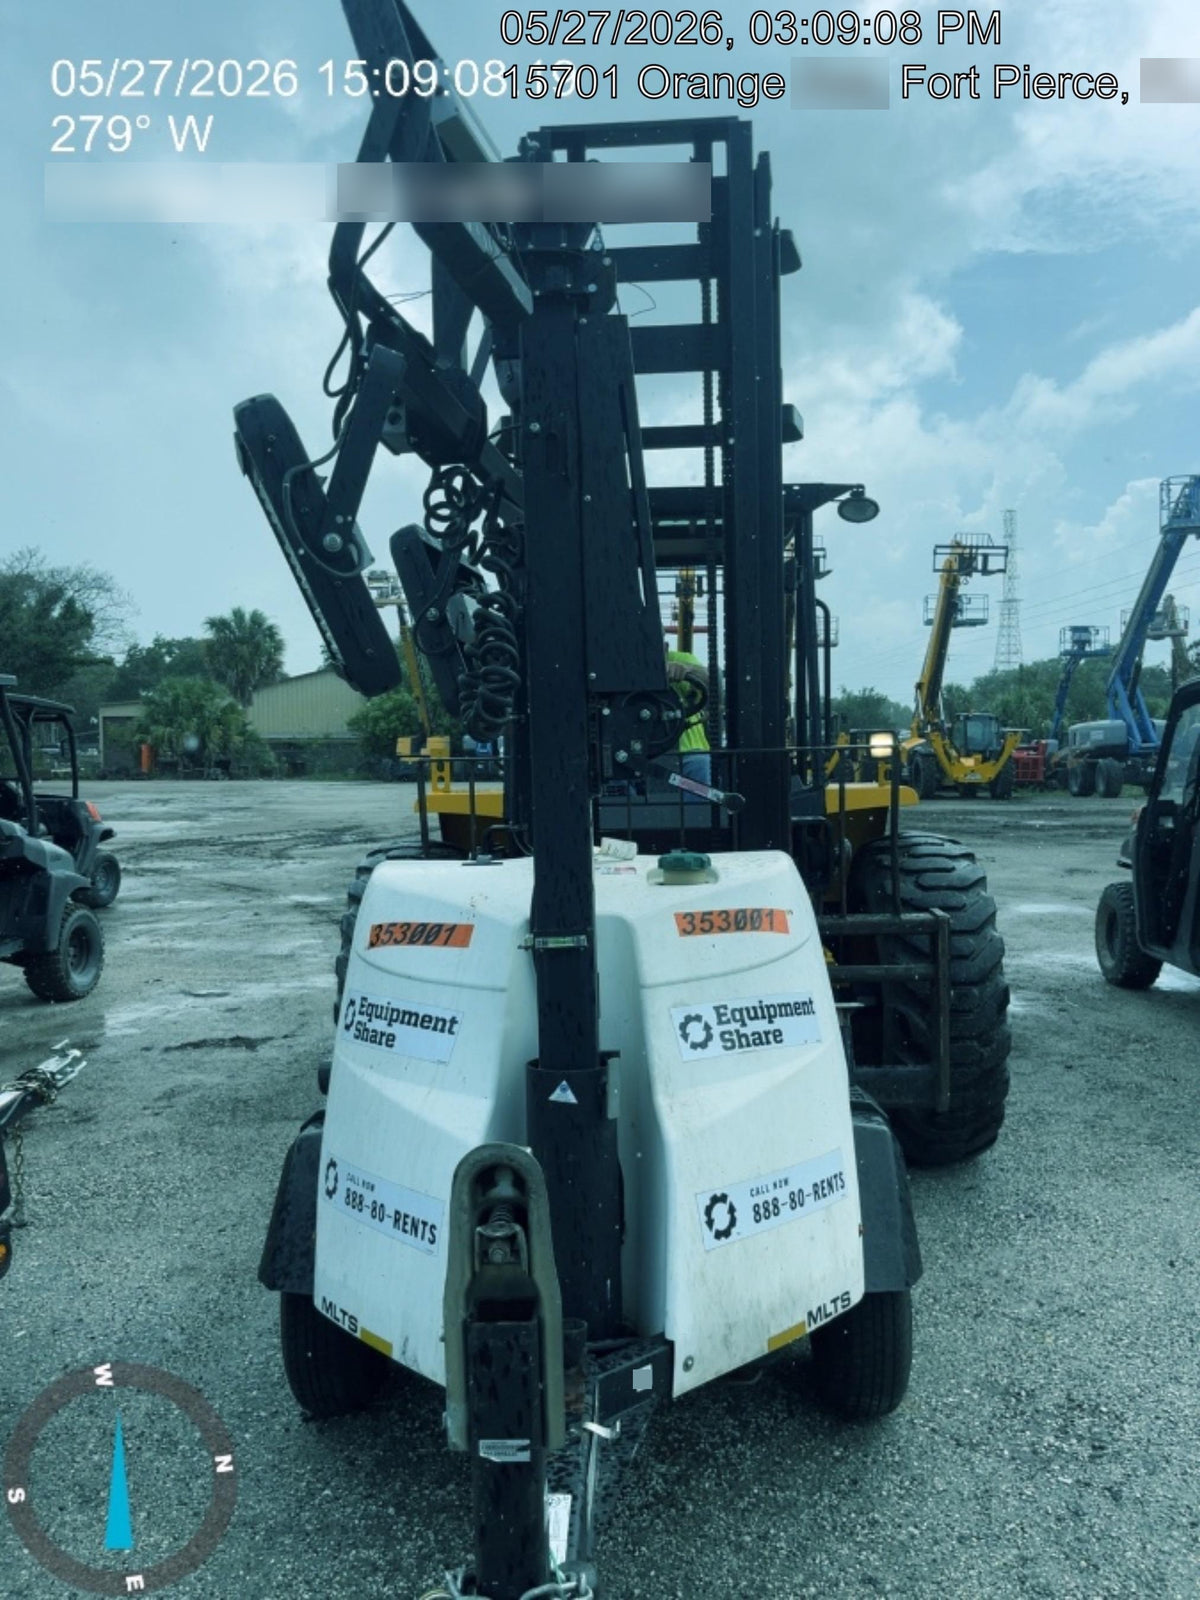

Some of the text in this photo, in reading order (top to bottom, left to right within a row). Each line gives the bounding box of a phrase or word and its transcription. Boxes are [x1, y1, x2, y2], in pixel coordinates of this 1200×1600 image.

[369, 923, 457, 947] 353001
[682, 909, 775, 936] 353001
[358, 996, 459, 1036] Equipment
[713, 997, 816, 1028] Equipment
[353, 1023, 396, 1048] Share
[719, 1027, 784, 1051] Share
[753, 1171, 846, 1224] 888-80-RENTS
[344, 1187, 437, 1245] 888-80-RENTS
[320, 1296, 359, 1334] MLTS
[806, 1291, 852, 1328] MLTS
